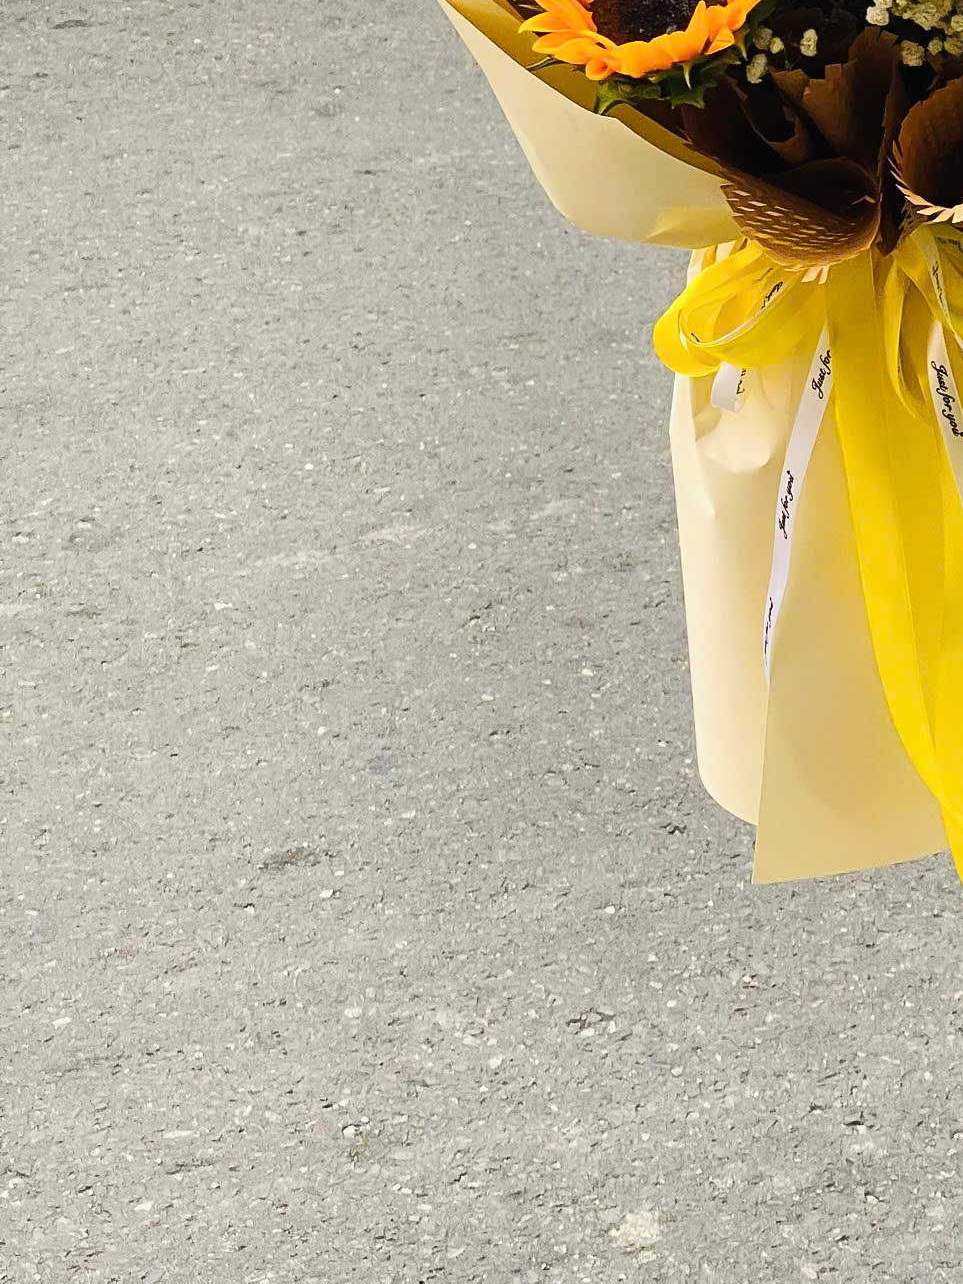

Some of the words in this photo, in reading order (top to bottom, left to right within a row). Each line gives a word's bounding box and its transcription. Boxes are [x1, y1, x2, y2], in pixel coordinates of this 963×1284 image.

[812, 368, 826, 399] Just
[820, 349, 831, 375] for
[931, 361, 948, 391] Just
[936, 388, 955, 412] for
[781, 495, 789, 519] for
[786, 470, 794, 501] you
